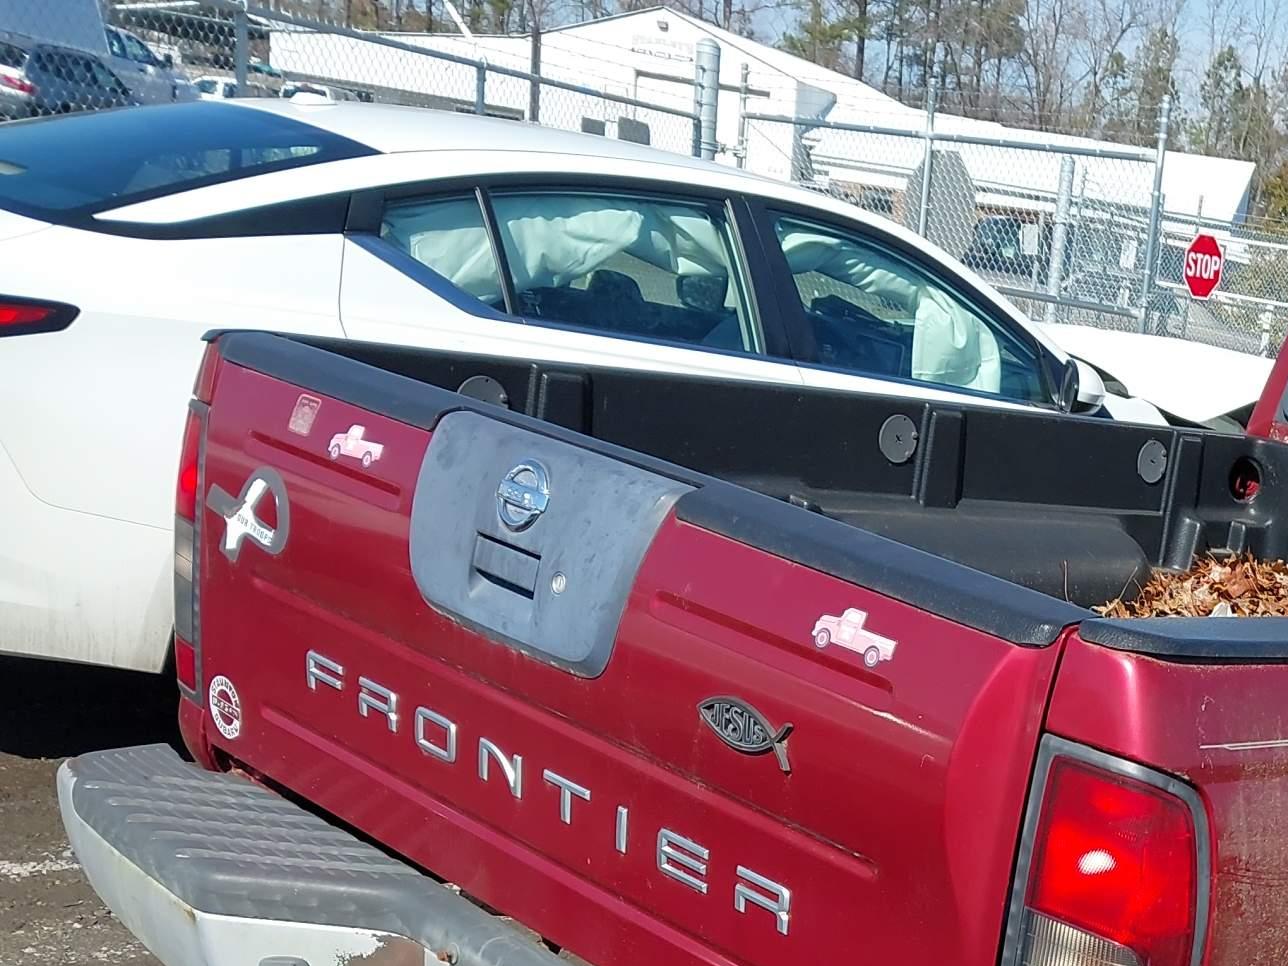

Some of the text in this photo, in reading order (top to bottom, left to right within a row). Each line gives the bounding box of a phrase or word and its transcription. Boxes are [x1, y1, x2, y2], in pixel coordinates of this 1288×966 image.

[1186, 251, 1220, 279] STOP
[237, 513, 248, 527] OUR
[710, 703, 765, 745] JESUS
[306, 649, 791, 935] FRONTIER
